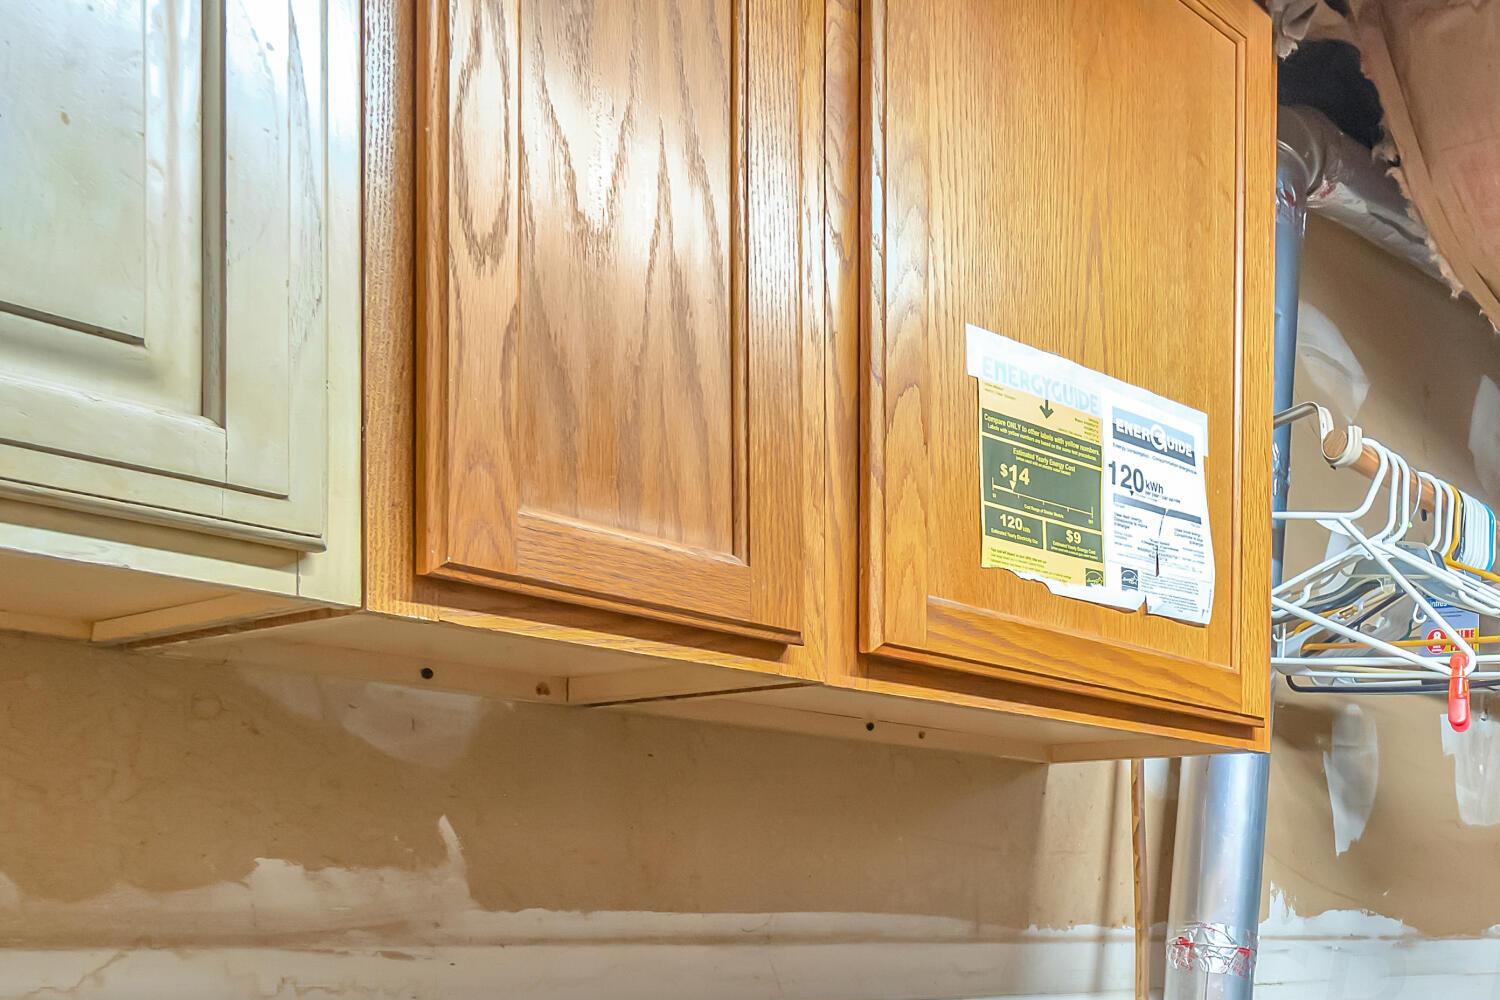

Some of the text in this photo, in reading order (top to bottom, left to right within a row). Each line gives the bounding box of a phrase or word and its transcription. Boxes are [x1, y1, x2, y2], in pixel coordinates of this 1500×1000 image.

[1007, 420, 1021, 431] ONLY
[1000, 463, 1030, 485] $14
[1109, 460, 1164, 494] 120 kWh
[1000, 514, 1023, 531] 120
[1066, 529, 1082, 544] $9
